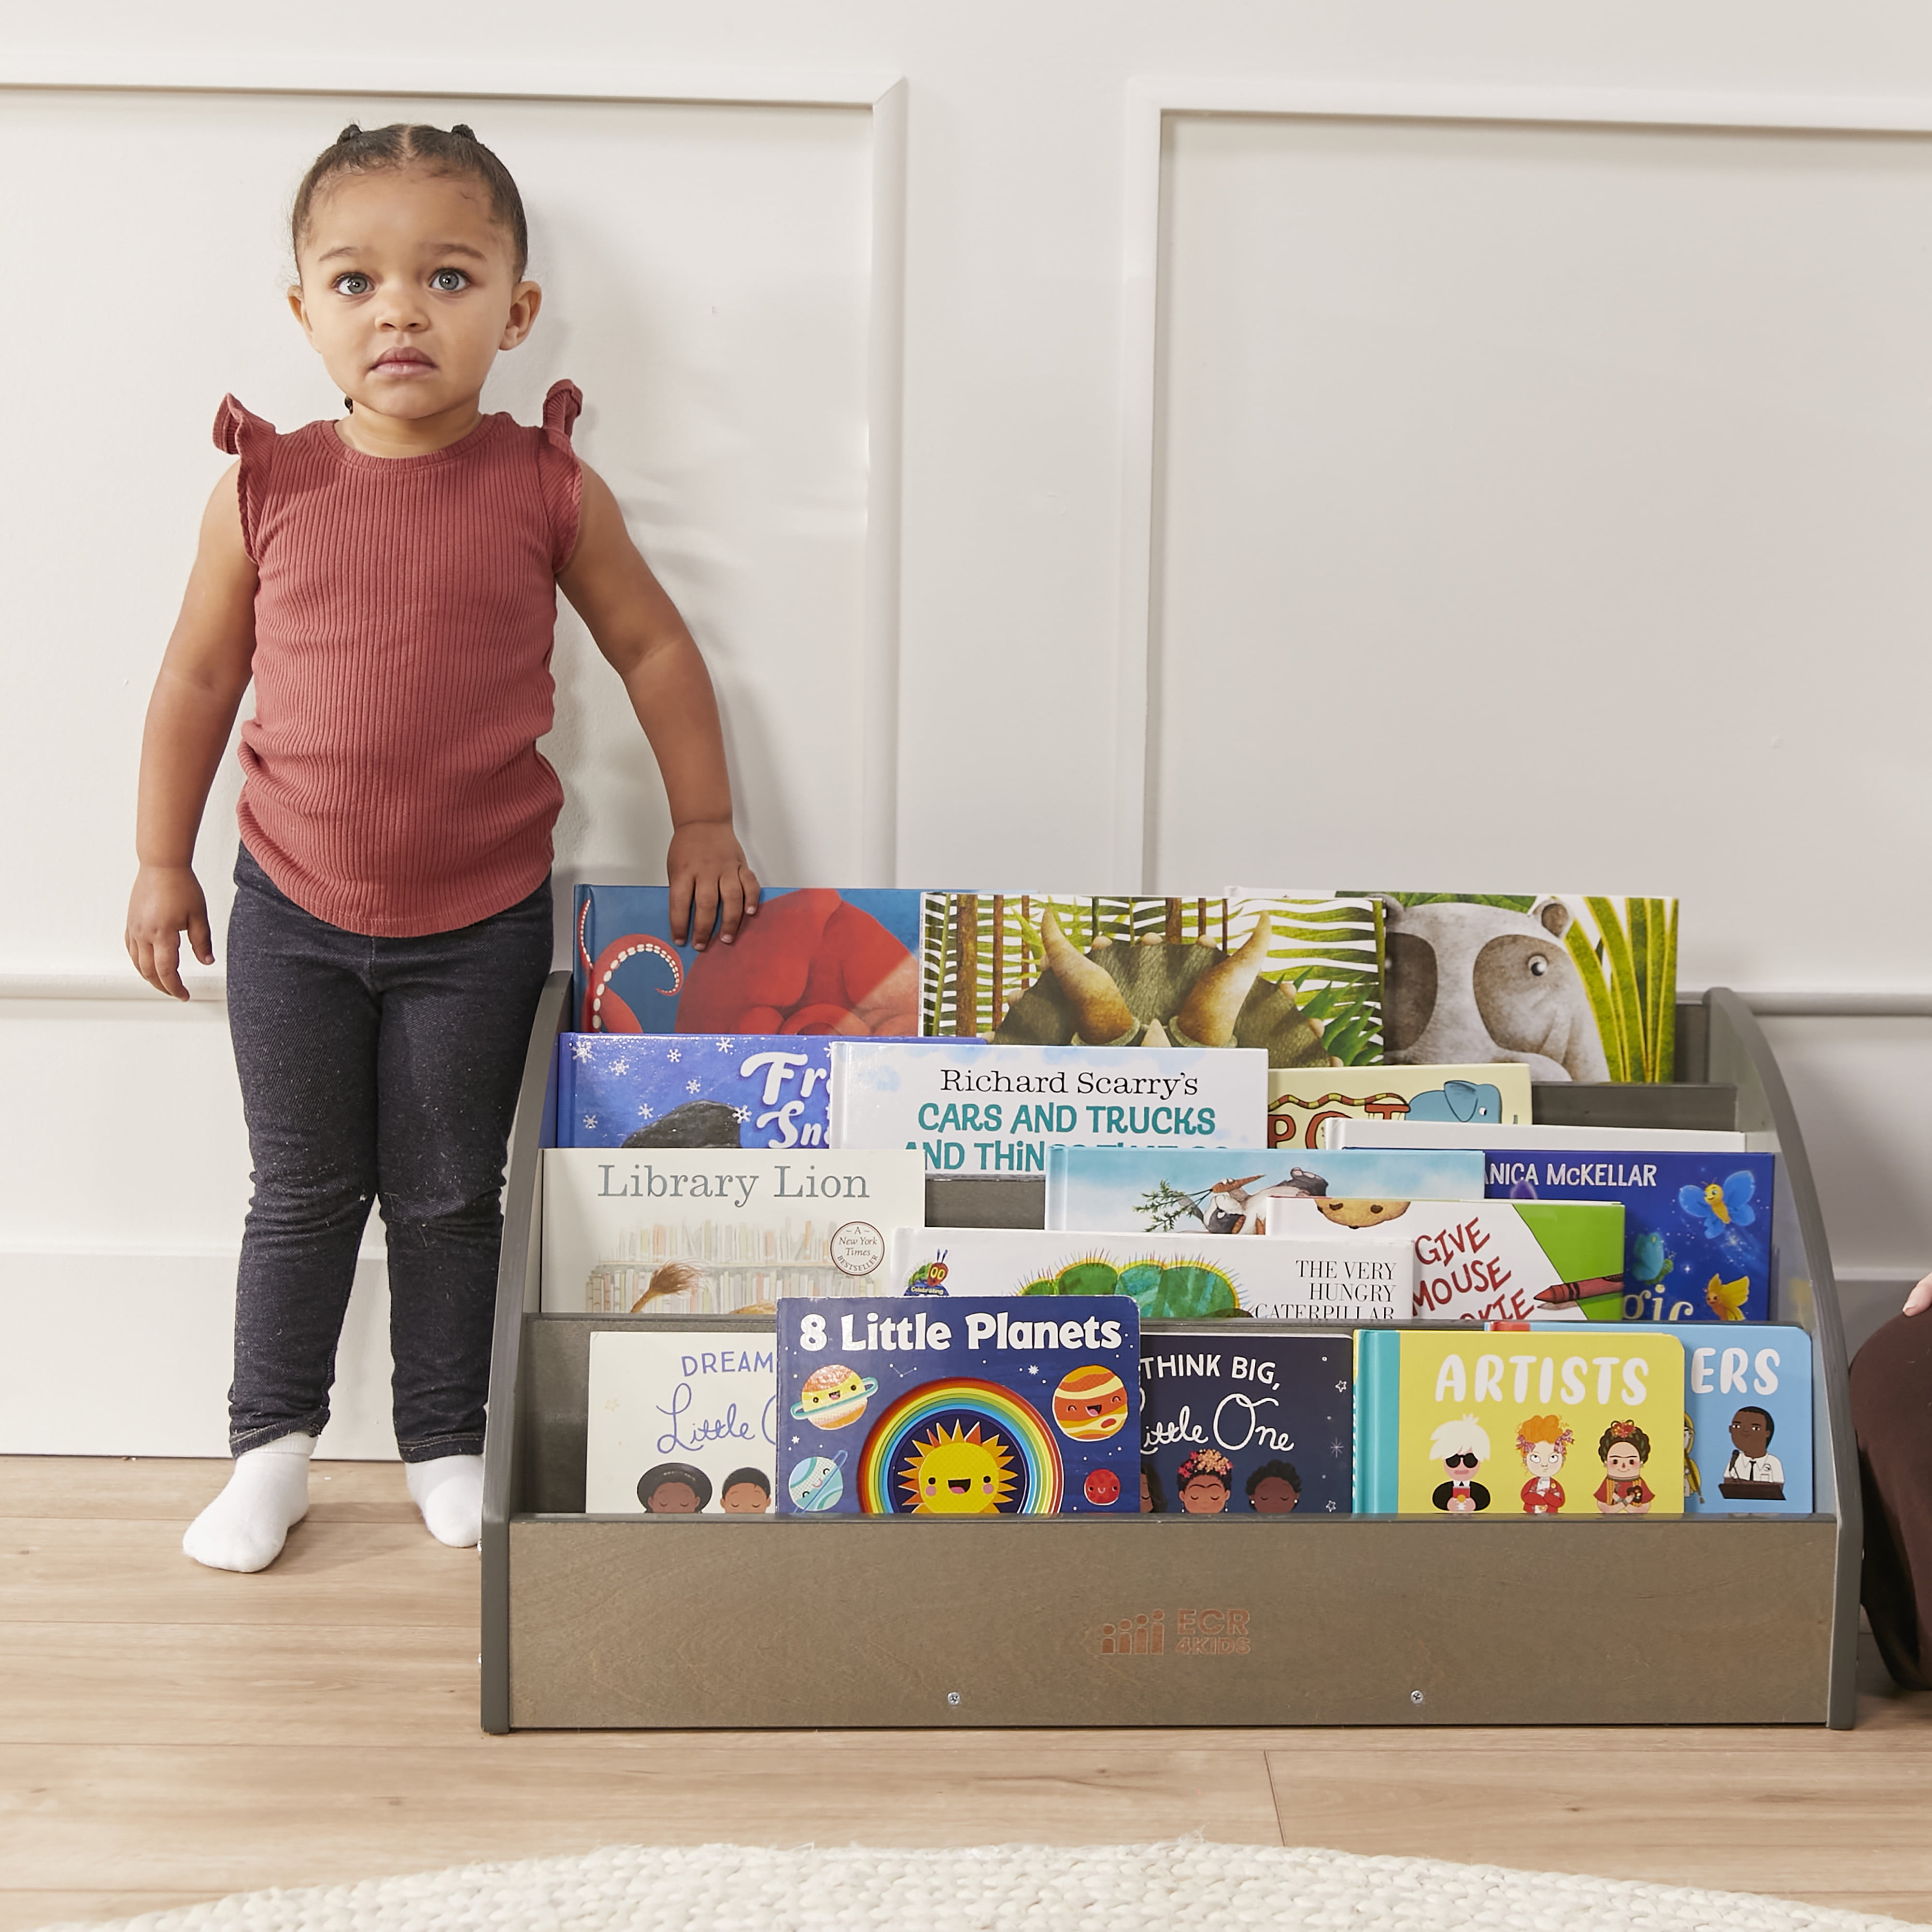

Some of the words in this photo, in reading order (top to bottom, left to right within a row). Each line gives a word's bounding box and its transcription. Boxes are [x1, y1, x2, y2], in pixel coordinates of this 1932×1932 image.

[740, 1051, 831, 1105] Fr
[940, 1069, 1068, 1094] Richard
[1077, 1072, 1199, 1100] Scarry's
[756, 1100, 830, 1149] Sn
[918, 1103, 1002, 1133] CARS
[1010, 1102, 1078, 1134] AND
[1085, 1106, 1216, 1135] TRUCKS
[906, 1139, 965, 1170] ND
[974, 1140, 1086, 1172] THiN
[597, 1165, 759, 1208] Library
[773, 1165, 870, 1198] Lion
[1483, 1163, 1539, 1185] NICA
[1546, 1163, 1657, 1187] McKELLAR
[838, 1236, 858, 1245] New
[860, 1236, 878, 1245] York
[854, 1226, 862, 1235] A
[1415, 1217, 1491, 1267] GIVE
[837, 1255, 879, 1271] BESTSELLER
[845, 1247, 871, 1256] Times
[1295, 1260, 1337, 1279] THE
[1343, 1261, 1397, 1280] VERY
[1412, 1256, 1511, 1317] MOUSE
[1308, 1282, 1397, 1303] HUNGRY
[1255, 1303, 1395, 1319] CATERPILLAR
[799, 1313, 827, 1352] 8
[840, 1312, 952, 1351] Little
[965, 1311, 1122, 1350] Planets
[681, 1350, 773, 1377] DREAM
[1139, 1354, 1222, 1380] THINK
[1232, 1356, 1280, 1391] BIG,
[1435, 1354, 1649, 1406] ARTISTS
[1691, 1347, 1780, 1396] ERS
[656, 1382, 755, 1454] Little
[1213, 1393, 1294, 1451] One
[1177, 1608, 1250, 1635] ECR
[1175, 1637, 1251, 1655] 4KIDS
